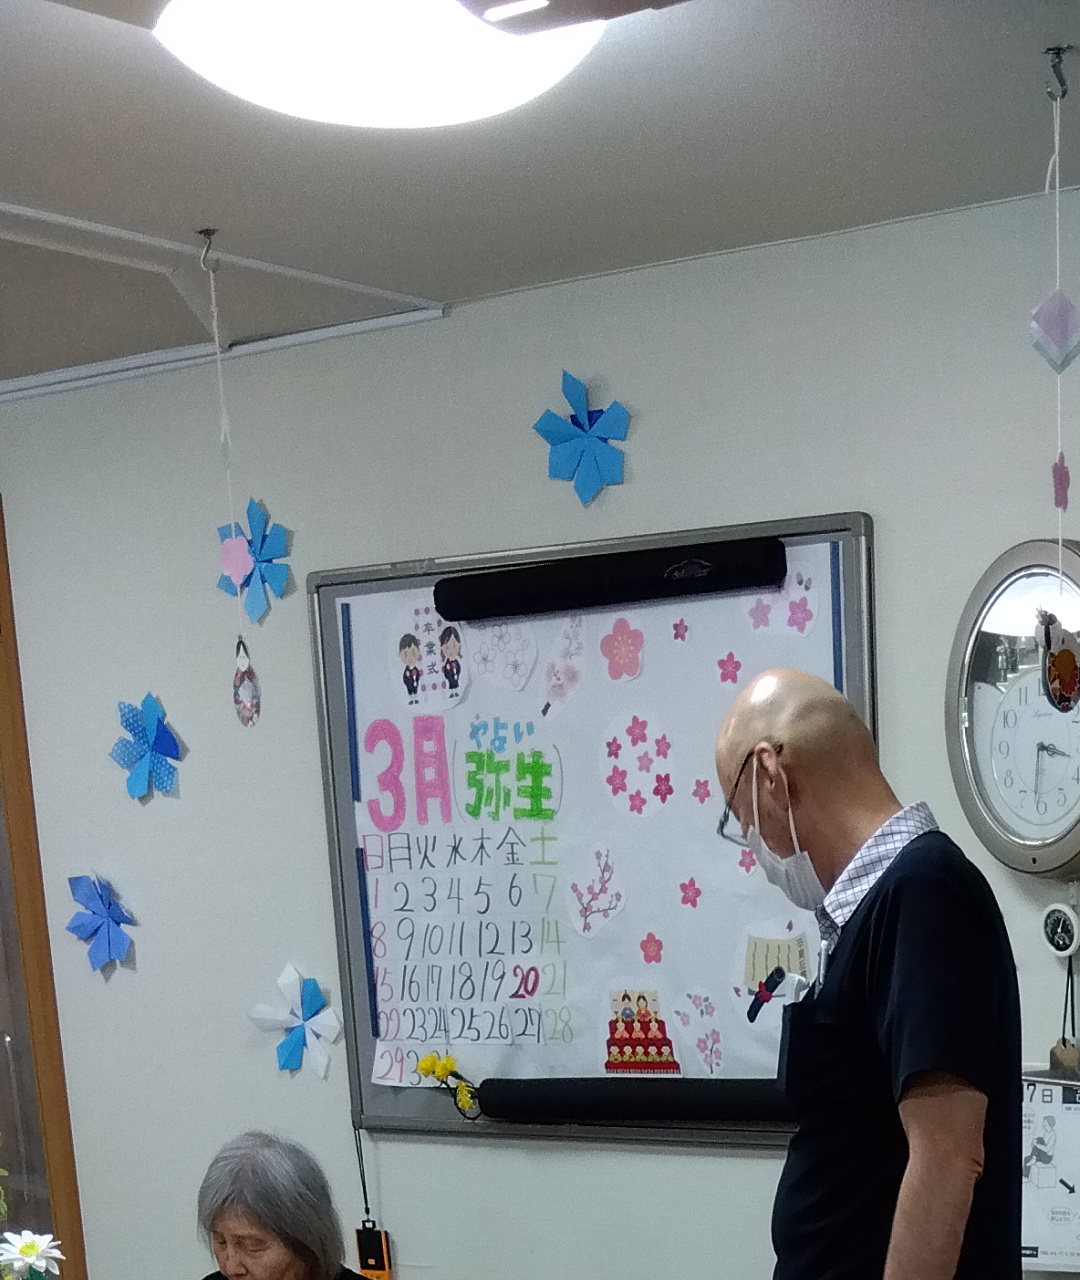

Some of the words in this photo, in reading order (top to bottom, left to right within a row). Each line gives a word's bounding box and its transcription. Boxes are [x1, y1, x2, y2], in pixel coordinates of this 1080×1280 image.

[423, 622, 439, 675] 卒業式
[1019, 687, 1028, 706] 11
[469, 714, 535, 753] やよい
[1003, 709, 1017, 729] 10
[999, 740, 1009, 759] 9
[364, 715, 452, 833] 3月
[1004, 768, 1013, 788] 8
[1072, 766, 1080, 785] 4
[1015, 789, 1027, 809] 7
[1057, 787, 1066, 807] 5
[373, 877, 379, 909] 1
[394, 881, 414, 912] 2
[421, 876, 437, 912] 3
[446, 877, 464, 914] 4
[474, 876, 493, 914] 5
[508, 873, 522, 908] 6
[533, 873, 557, 911] 7
[370, 921, 387, 959] 8
[396, 917, 415, 961] 9
[422, 922, 444, 958] 10
[449, 921, 465, 955] 11
[478, 920, 505, 958] 12
[511, 920, 533, 955] 13
[540, 917, 566, 956] 14
[374, 966, 394, 1002] 15
[400, 964, 420, 1002] 16
[427, 964, 442, 1002] 17
[450, 962, 475, 1000] 18
[480, 959, 506, 1002] 19
[509, 964, 540, 999] 20
[541, 959, 567, 1001] 21
[378, 1007, 401, 1042] 22
[403, 1007, 427, 1042] 23
[428, 1006, 449, 1041] 24
[451, 1007, 481, 1041] 25
[483, 1006, 509, 1040] 26
[514, 1006, 541, 1044] 27
[545, 1006, 574, 1043] 28
[379, 1046, 405, 1083] 29
